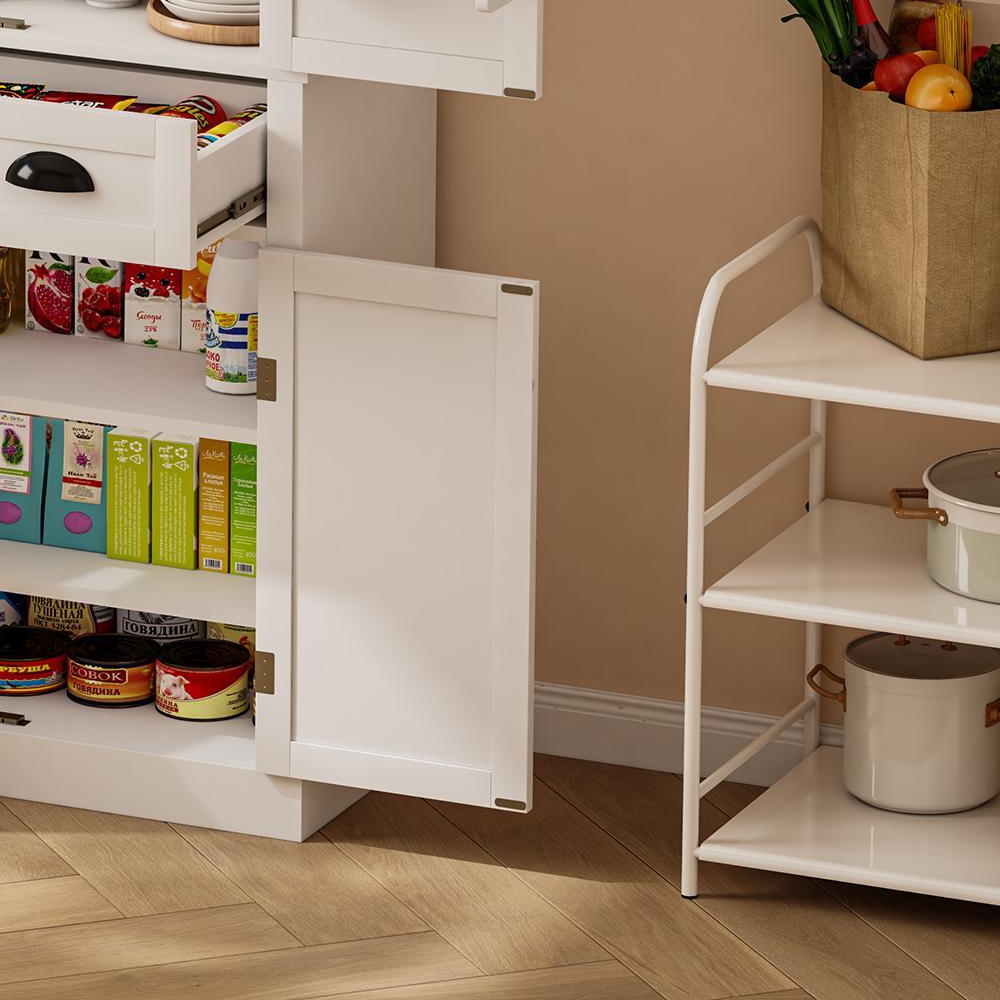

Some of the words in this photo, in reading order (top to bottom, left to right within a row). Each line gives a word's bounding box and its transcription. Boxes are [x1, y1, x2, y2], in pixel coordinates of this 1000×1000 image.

[125, 621, 196, 637] ГОВЯДИНА
[71, 664, 123, 682] СОВОК
[73, 682, 121, 696] ГОВЯДИНА
